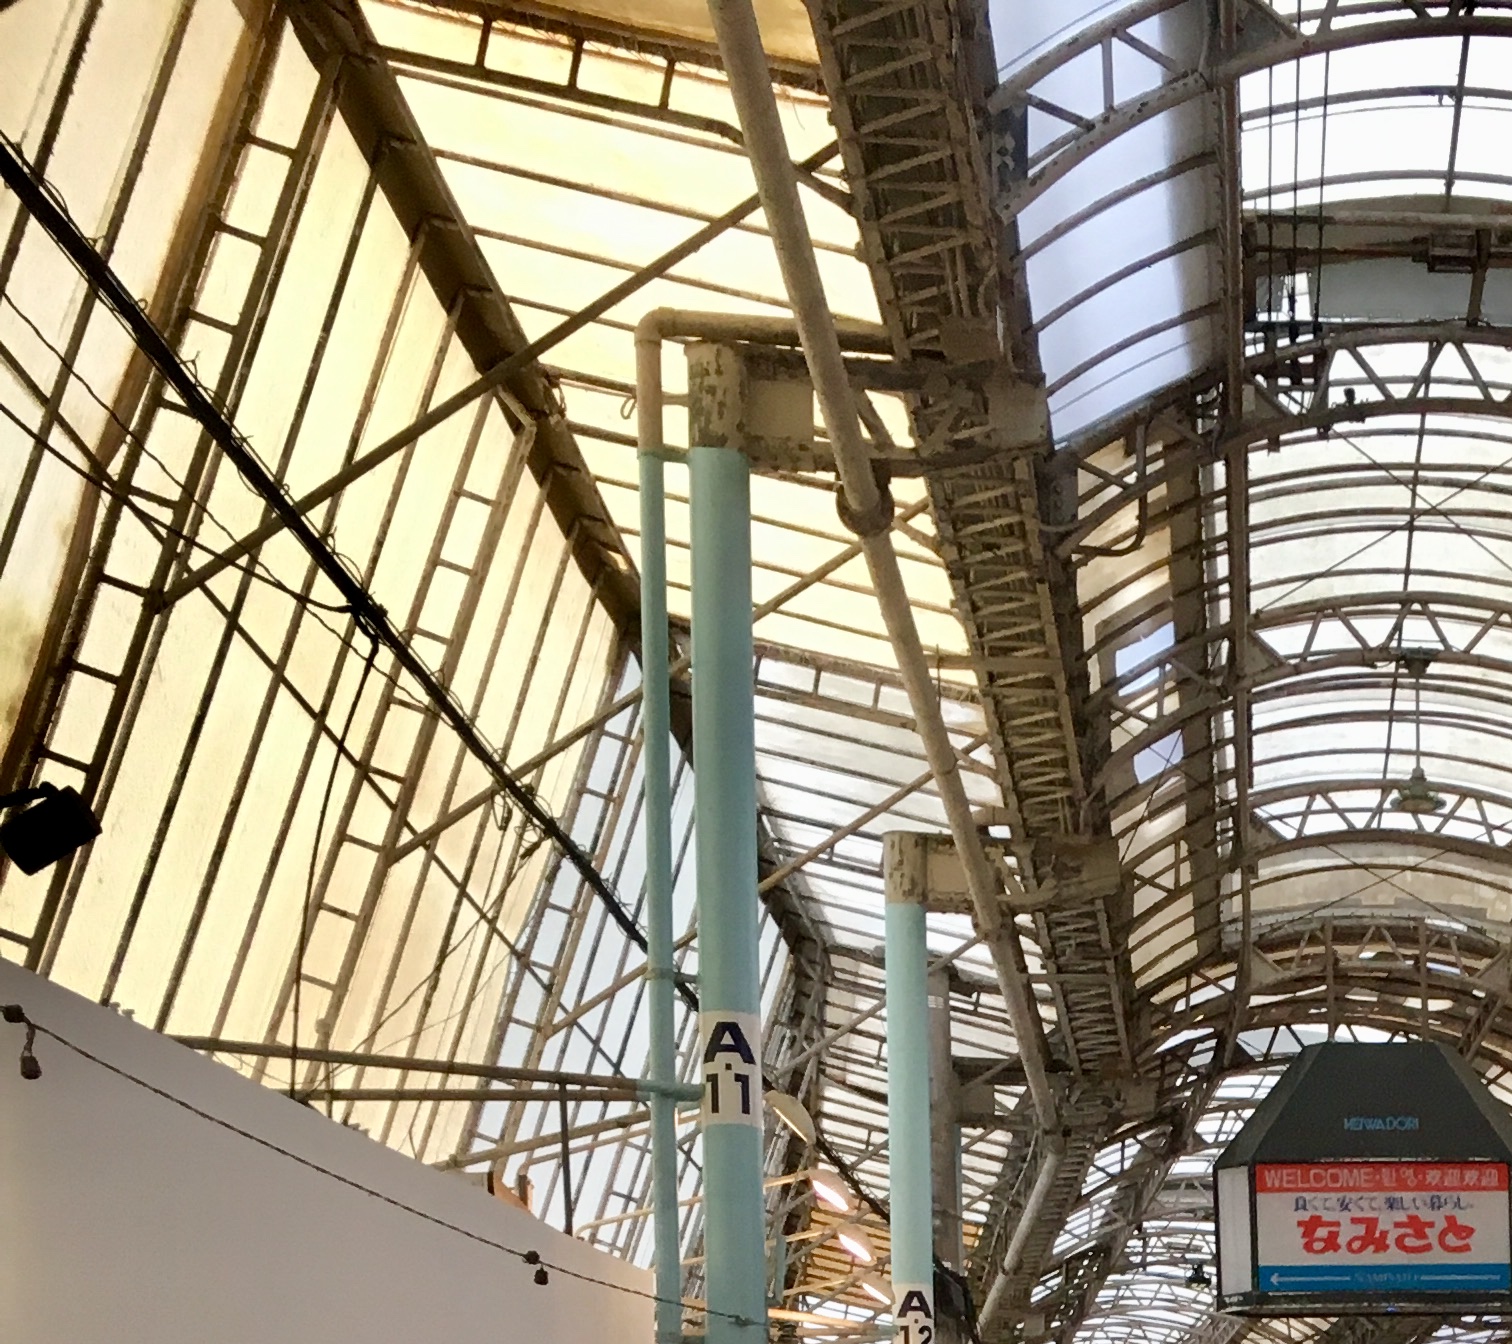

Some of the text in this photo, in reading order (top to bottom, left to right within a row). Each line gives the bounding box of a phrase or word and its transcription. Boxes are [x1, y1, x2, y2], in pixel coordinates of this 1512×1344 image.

[704, 1021, 756, 1065] A
[1297, 1213, 1476, 1255] なみさと
[897, 1290, 933, 1319] A
